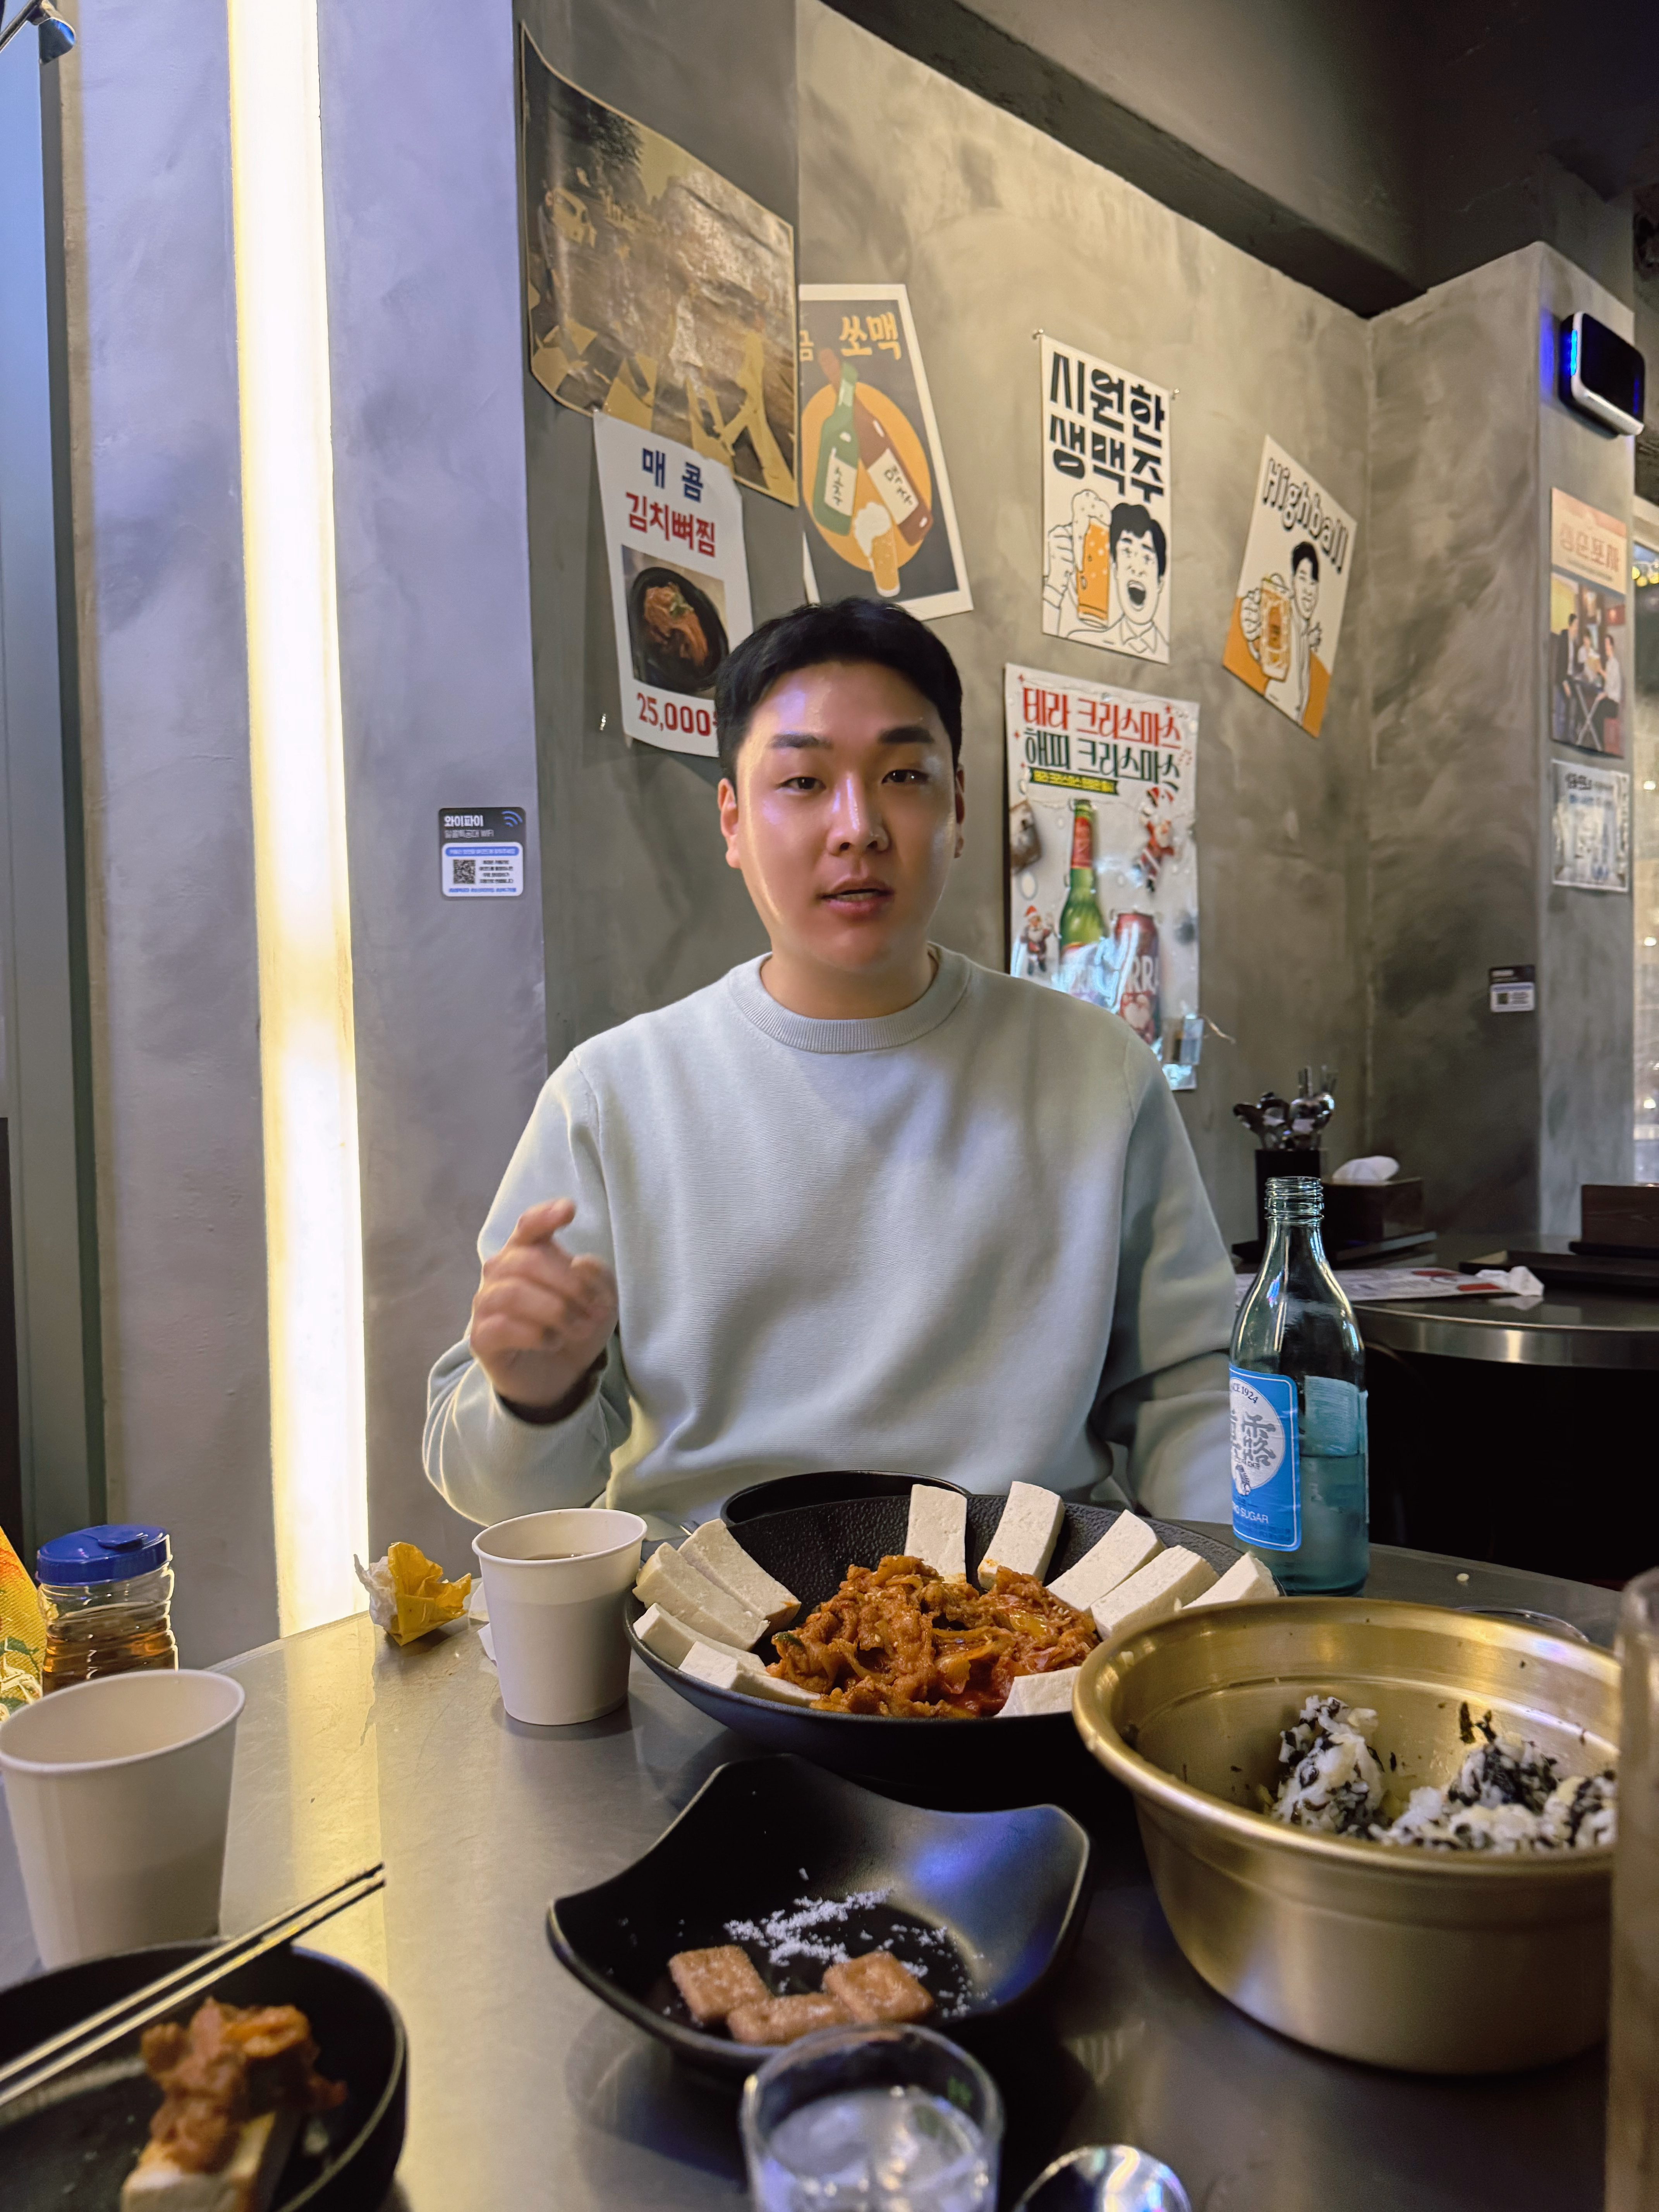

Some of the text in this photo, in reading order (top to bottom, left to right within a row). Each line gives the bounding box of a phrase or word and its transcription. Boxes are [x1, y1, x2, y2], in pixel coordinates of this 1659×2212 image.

[839, 311, 902, 360] 쏘맥
[1050, 351, 1165, 449] 시원한
[1049, 414, 1164, 504] 생맥주
[626, 491, 716, 558] 김치뼈찜
[1263, 457, 1348, 574] Highball
[637, 692, 718, 736] 25,000
[1023, 687, 1181, 749] 테라 크리스마스
[1024, 728, 1070, 770] 해피
[1077, 738, 1180, 792] 크리스마스
[444, 815, 483, 827] 와이파이
[1242, 1386, 1258, 1404] 1924
[1240, 1507, 1269, 1524] SUGAR
